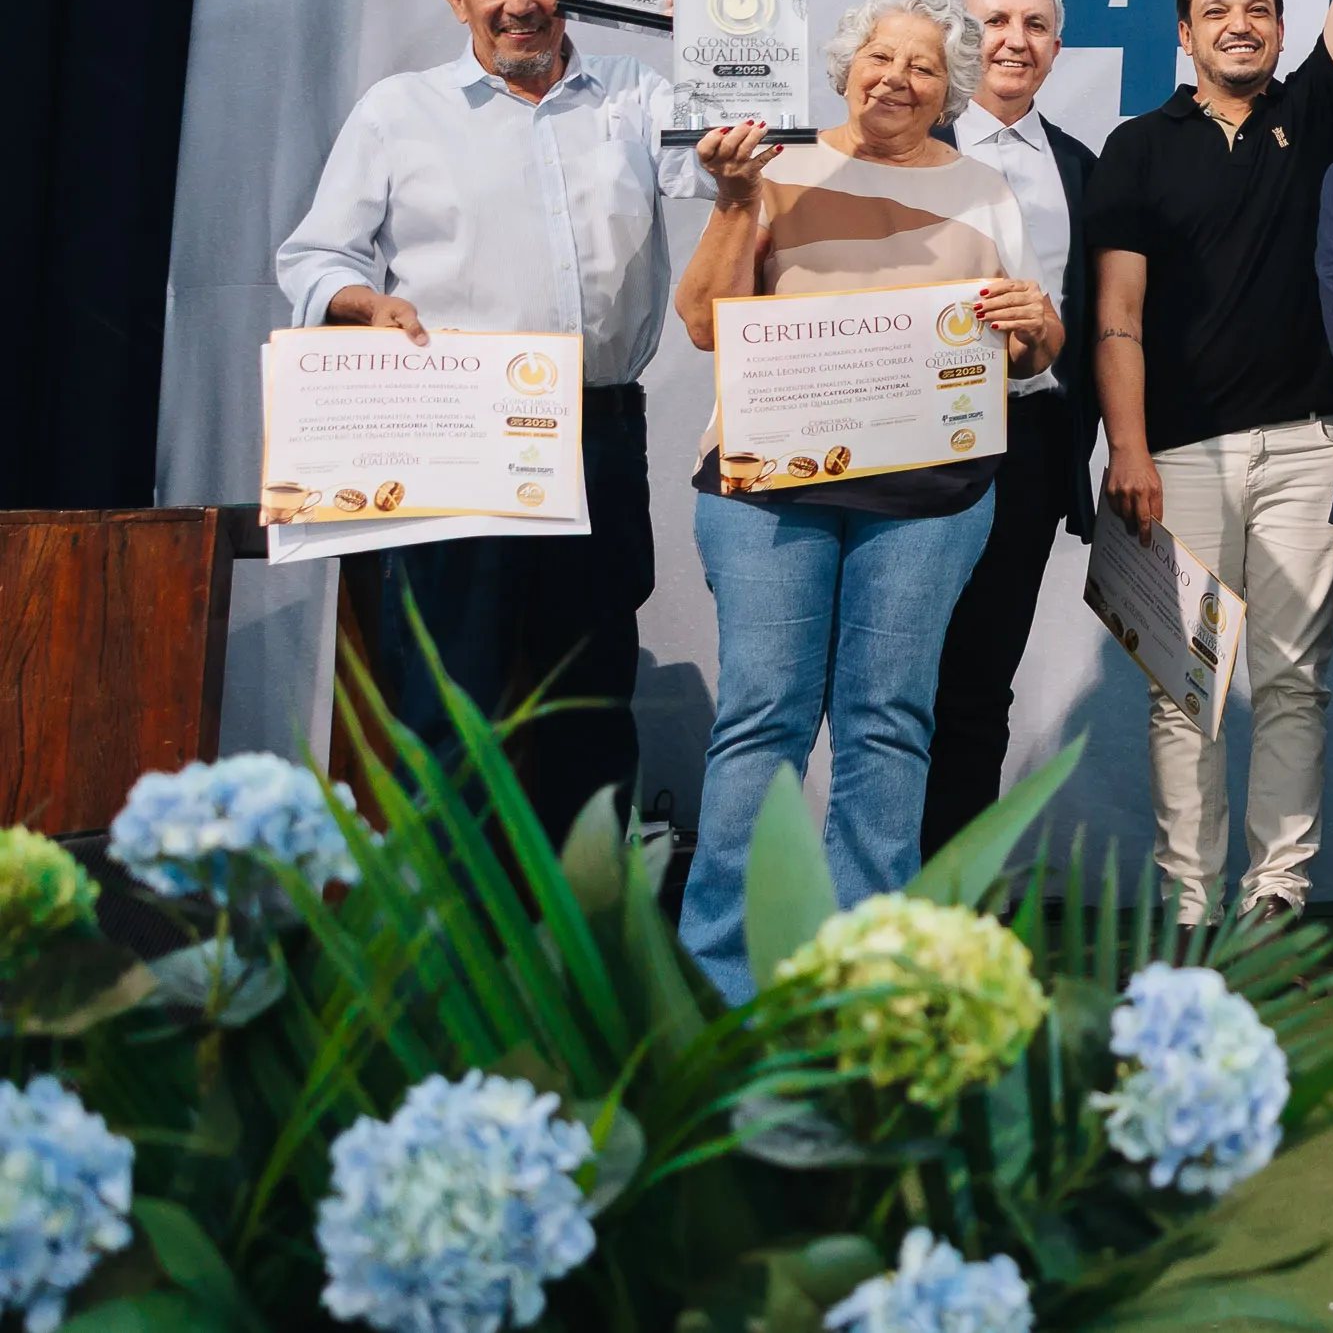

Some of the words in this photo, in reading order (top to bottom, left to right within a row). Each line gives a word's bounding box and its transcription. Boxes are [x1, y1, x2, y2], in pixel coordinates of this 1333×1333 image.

[697, 37, 777, 48] CONCURSO
[683, 47, 800, 65] QUALIDADE
[735, 65, 766, 75] 2025
[748, 81, 789, 89] NATURAL
[742, 313, 912, 344] CERTIFICADO
[934, 347, 983, 359] CONCURSO
[299, 352, 481, 373] CERTIFICADO
[925, 351, 997, 369] QUALIDADE
[743, 369, 774, 379] MARIA
[776, 366, 817, 377] LEONOR
[820, 360, 874, 372] GUIMARÃES
[876, 356, 914, 367] CORREA
[955, 366, 983, 377] 2025
[759, 393, 809, 404] COLOCAÇÃO
[823, 388, 868, 397] CATEGORIA
[874, 382, 911, 392] NATURAL
[355, 395, 417, 406] GONÇALVES
[754, 404, 797, 414] CONCURSO
[811, 399, 853, 410] QUALIDADE
[855, 395, 885, 403] SENHOR
[905, 388, 922, 397] 2025
[493, 402, 570, 416] QUALIDADE
[310, 423, 364, 432] COLOCAÇÃO
[380, 422, 428, 430] CATEGORIA
[524, 419, 555, 428] 2025
[801, 421, 864, 437] QUALIDADE
[352, 455, 421, 468] QUALIDADE
